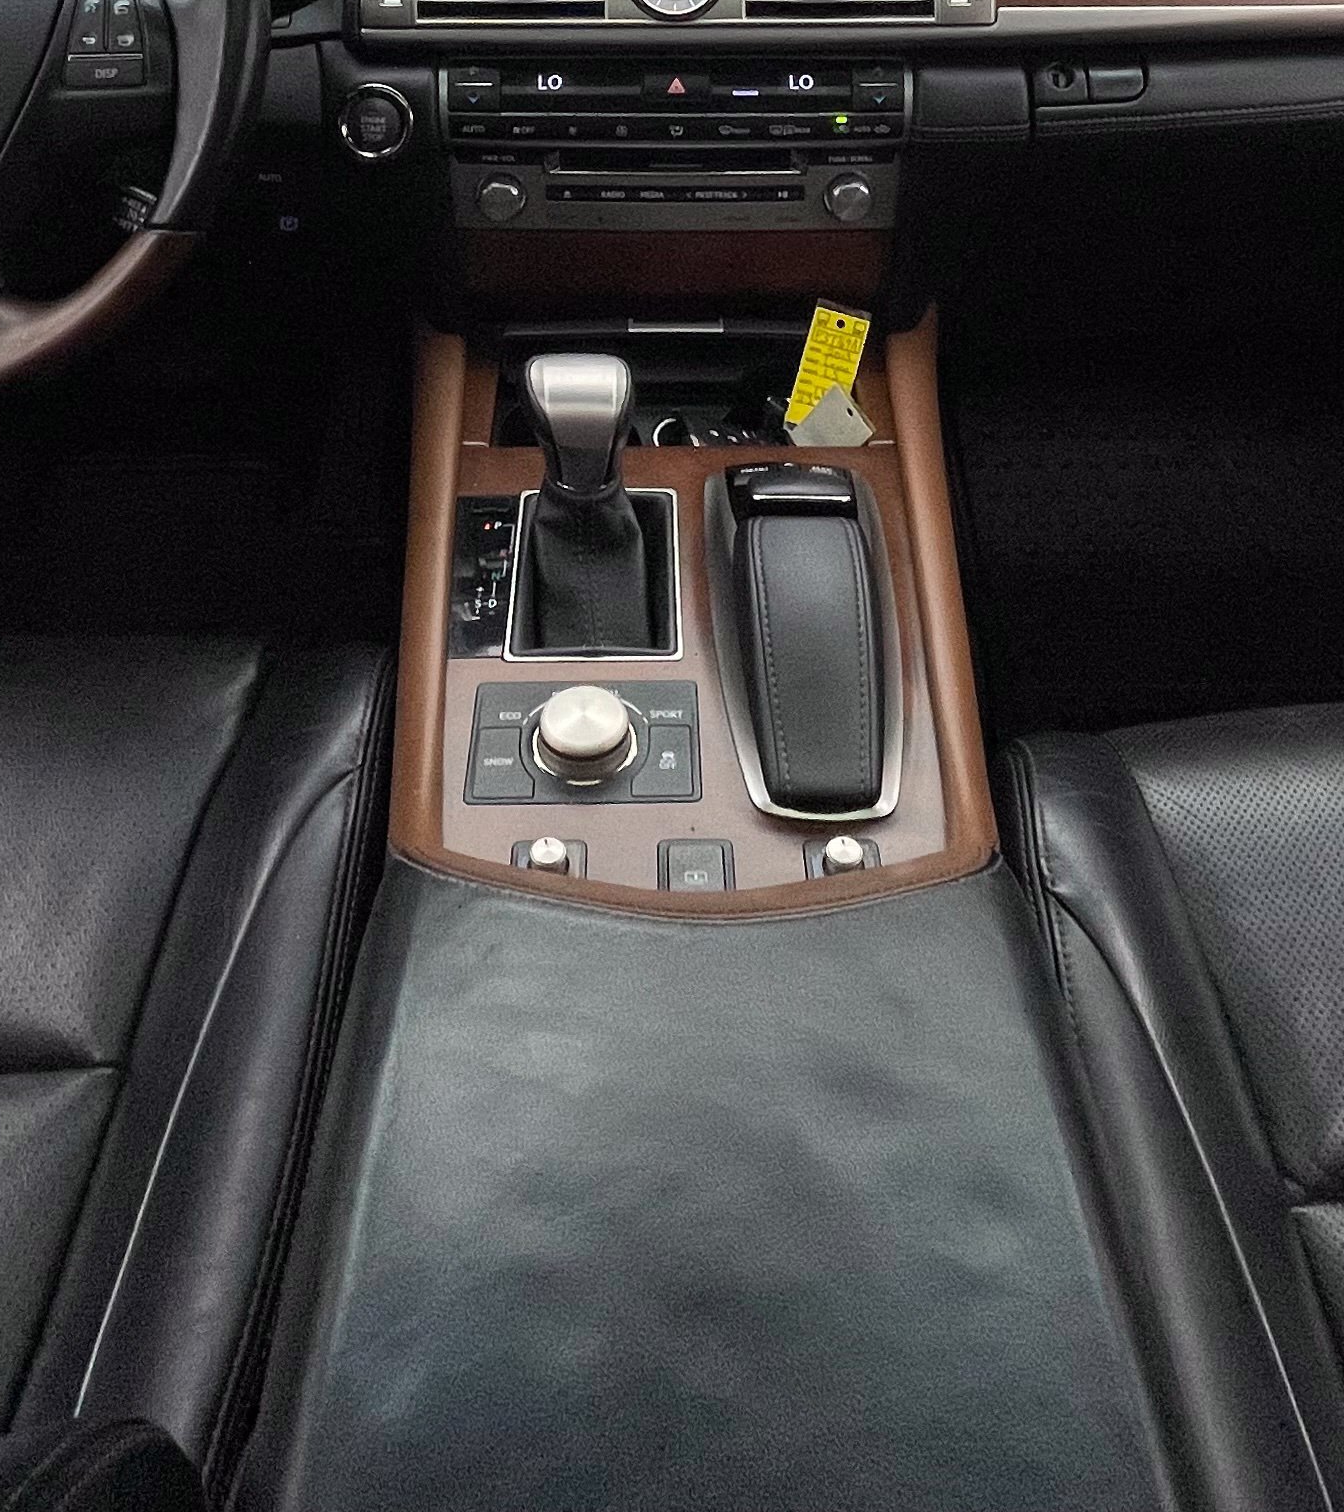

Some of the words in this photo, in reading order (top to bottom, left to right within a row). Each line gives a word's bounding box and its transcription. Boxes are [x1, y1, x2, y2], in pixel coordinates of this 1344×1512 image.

[94, 68, 119, 79] DISP
[537, 73, 563, 91] LO
[788, 73, 814, 91] LO
[462, 124, 486, 133] AUTO
[494, 520, 503, 530] P
[474, 598, 482, 609] S
[487, 598, 498, 609] D
[499, 711, 522, 721] ECO
[649, 709, 683, 720] SPORT
[483, 756, 514, 767] SNOW
